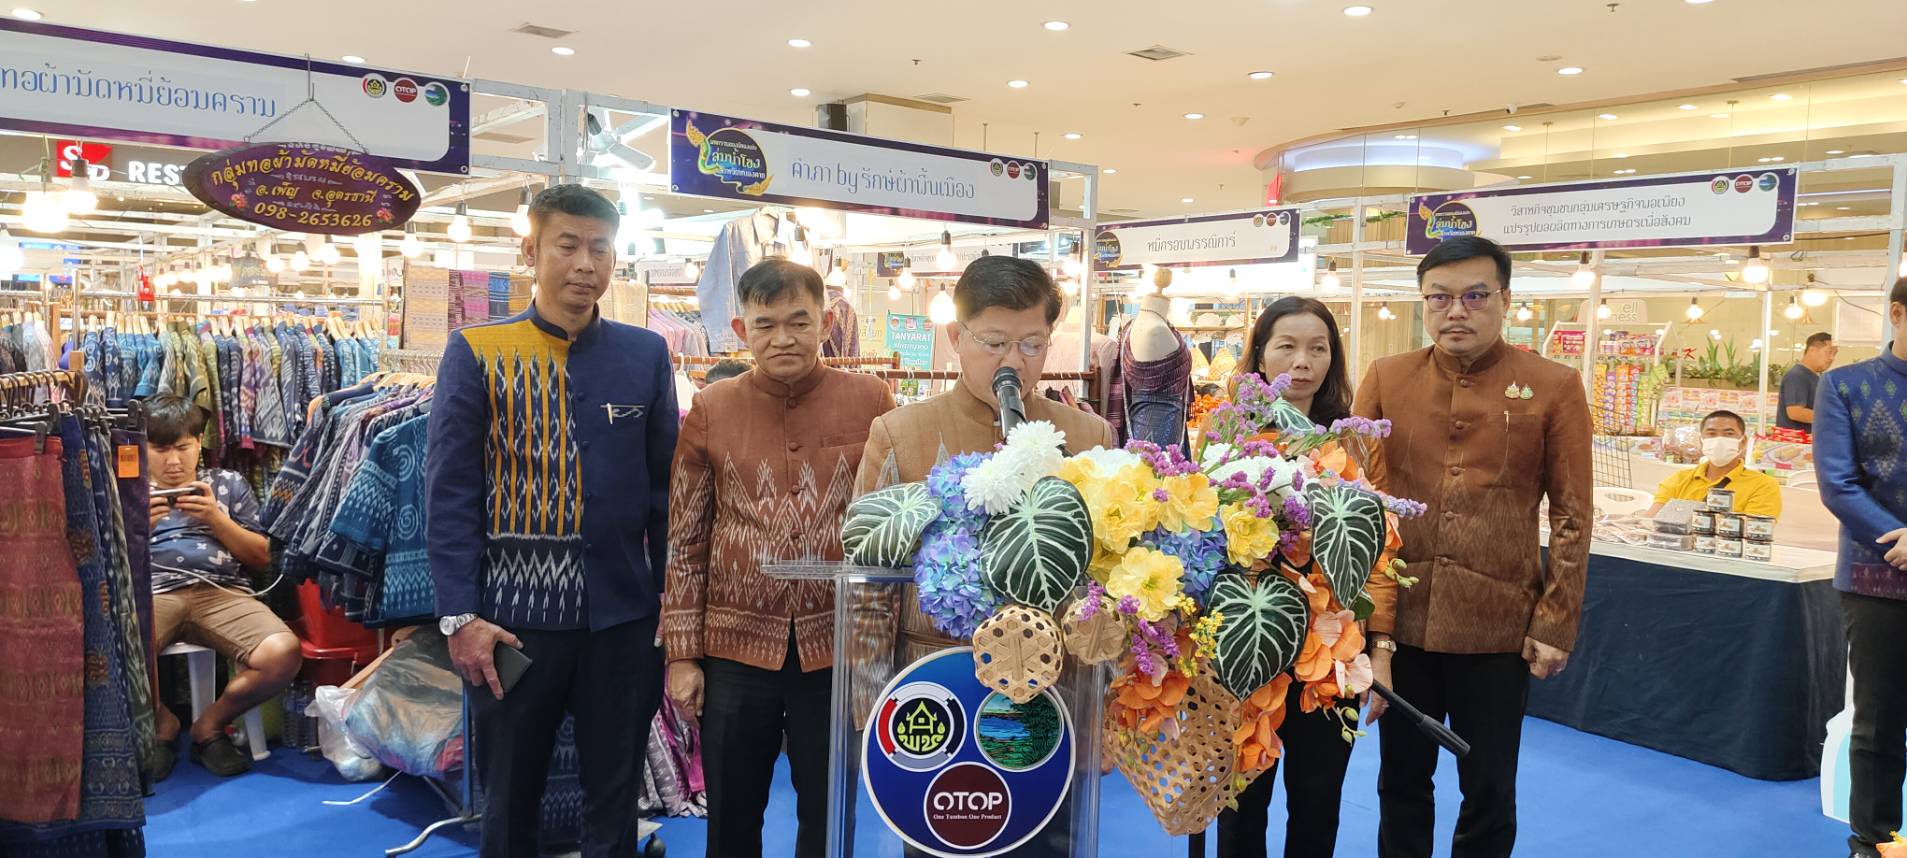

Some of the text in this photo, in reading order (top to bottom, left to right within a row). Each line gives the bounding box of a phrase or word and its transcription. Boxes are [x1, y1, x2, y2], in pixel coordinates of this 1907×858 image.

[0, 62, 277, 118] ทอผ้ามัดหมี่ย้อมคราม
[128, 160, 187, 186] RES
[837, 162, 858, 194] by
[254, 202, 373, 227] 098-2653626
[933, 791, 1003, 811] OTOP
